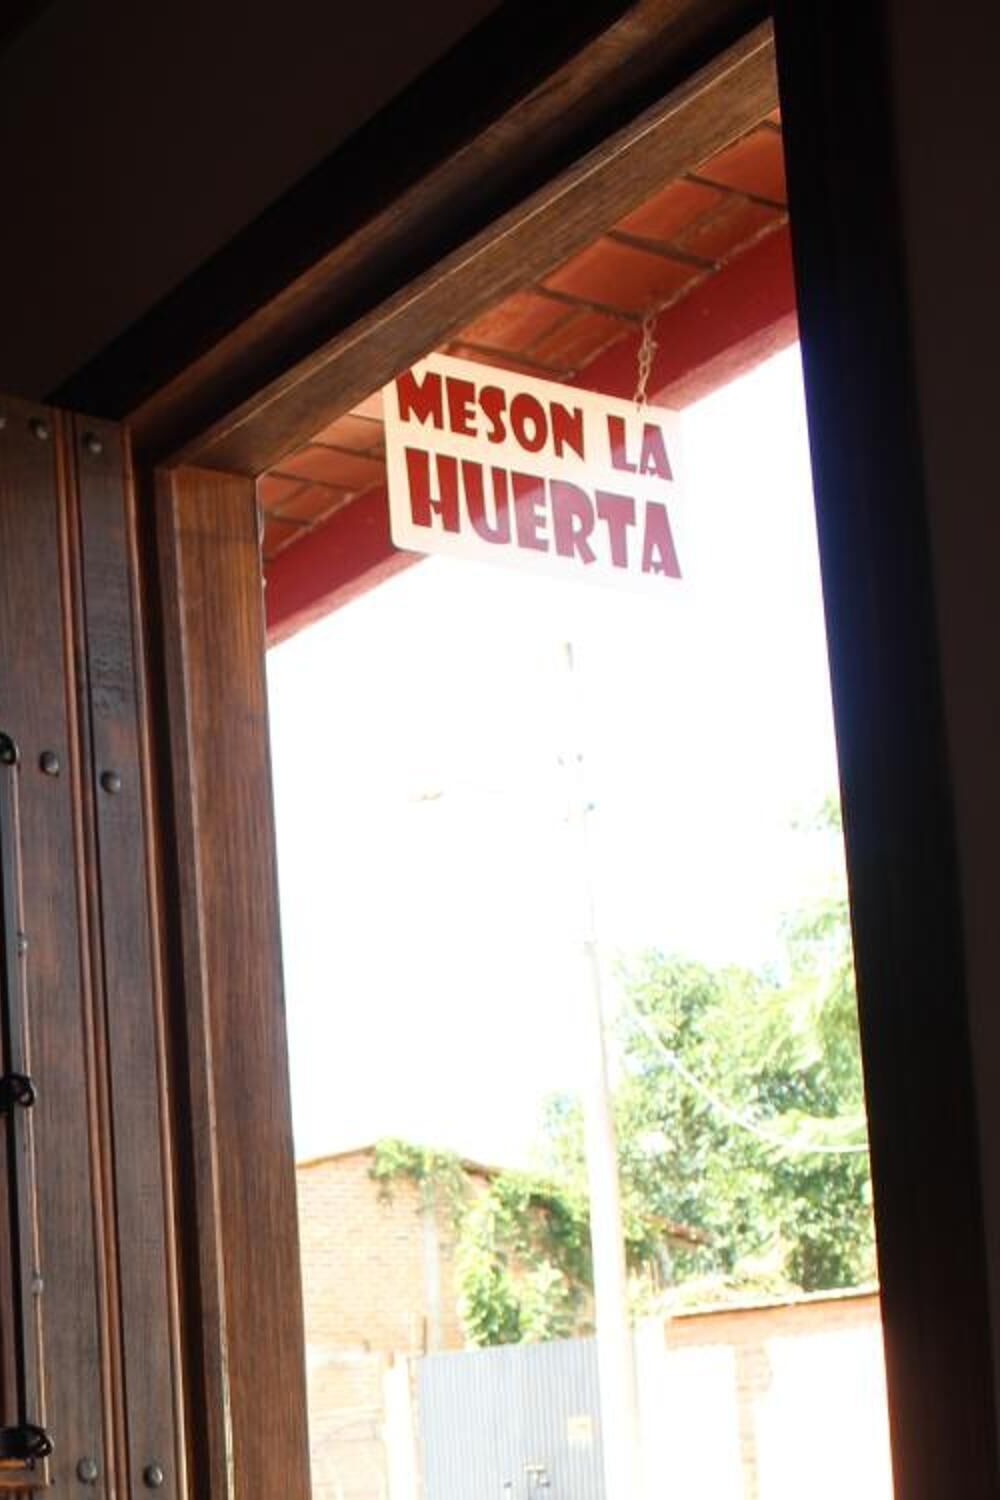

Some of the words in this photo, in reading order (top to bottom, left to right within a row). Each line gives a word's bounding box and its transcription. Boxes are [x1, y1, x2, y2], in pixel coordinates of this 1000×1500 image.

[395, 369, 586, 462] MESON
[606, 414, 674, 482] LA
[404, 446, 683, 579] HUERTA
